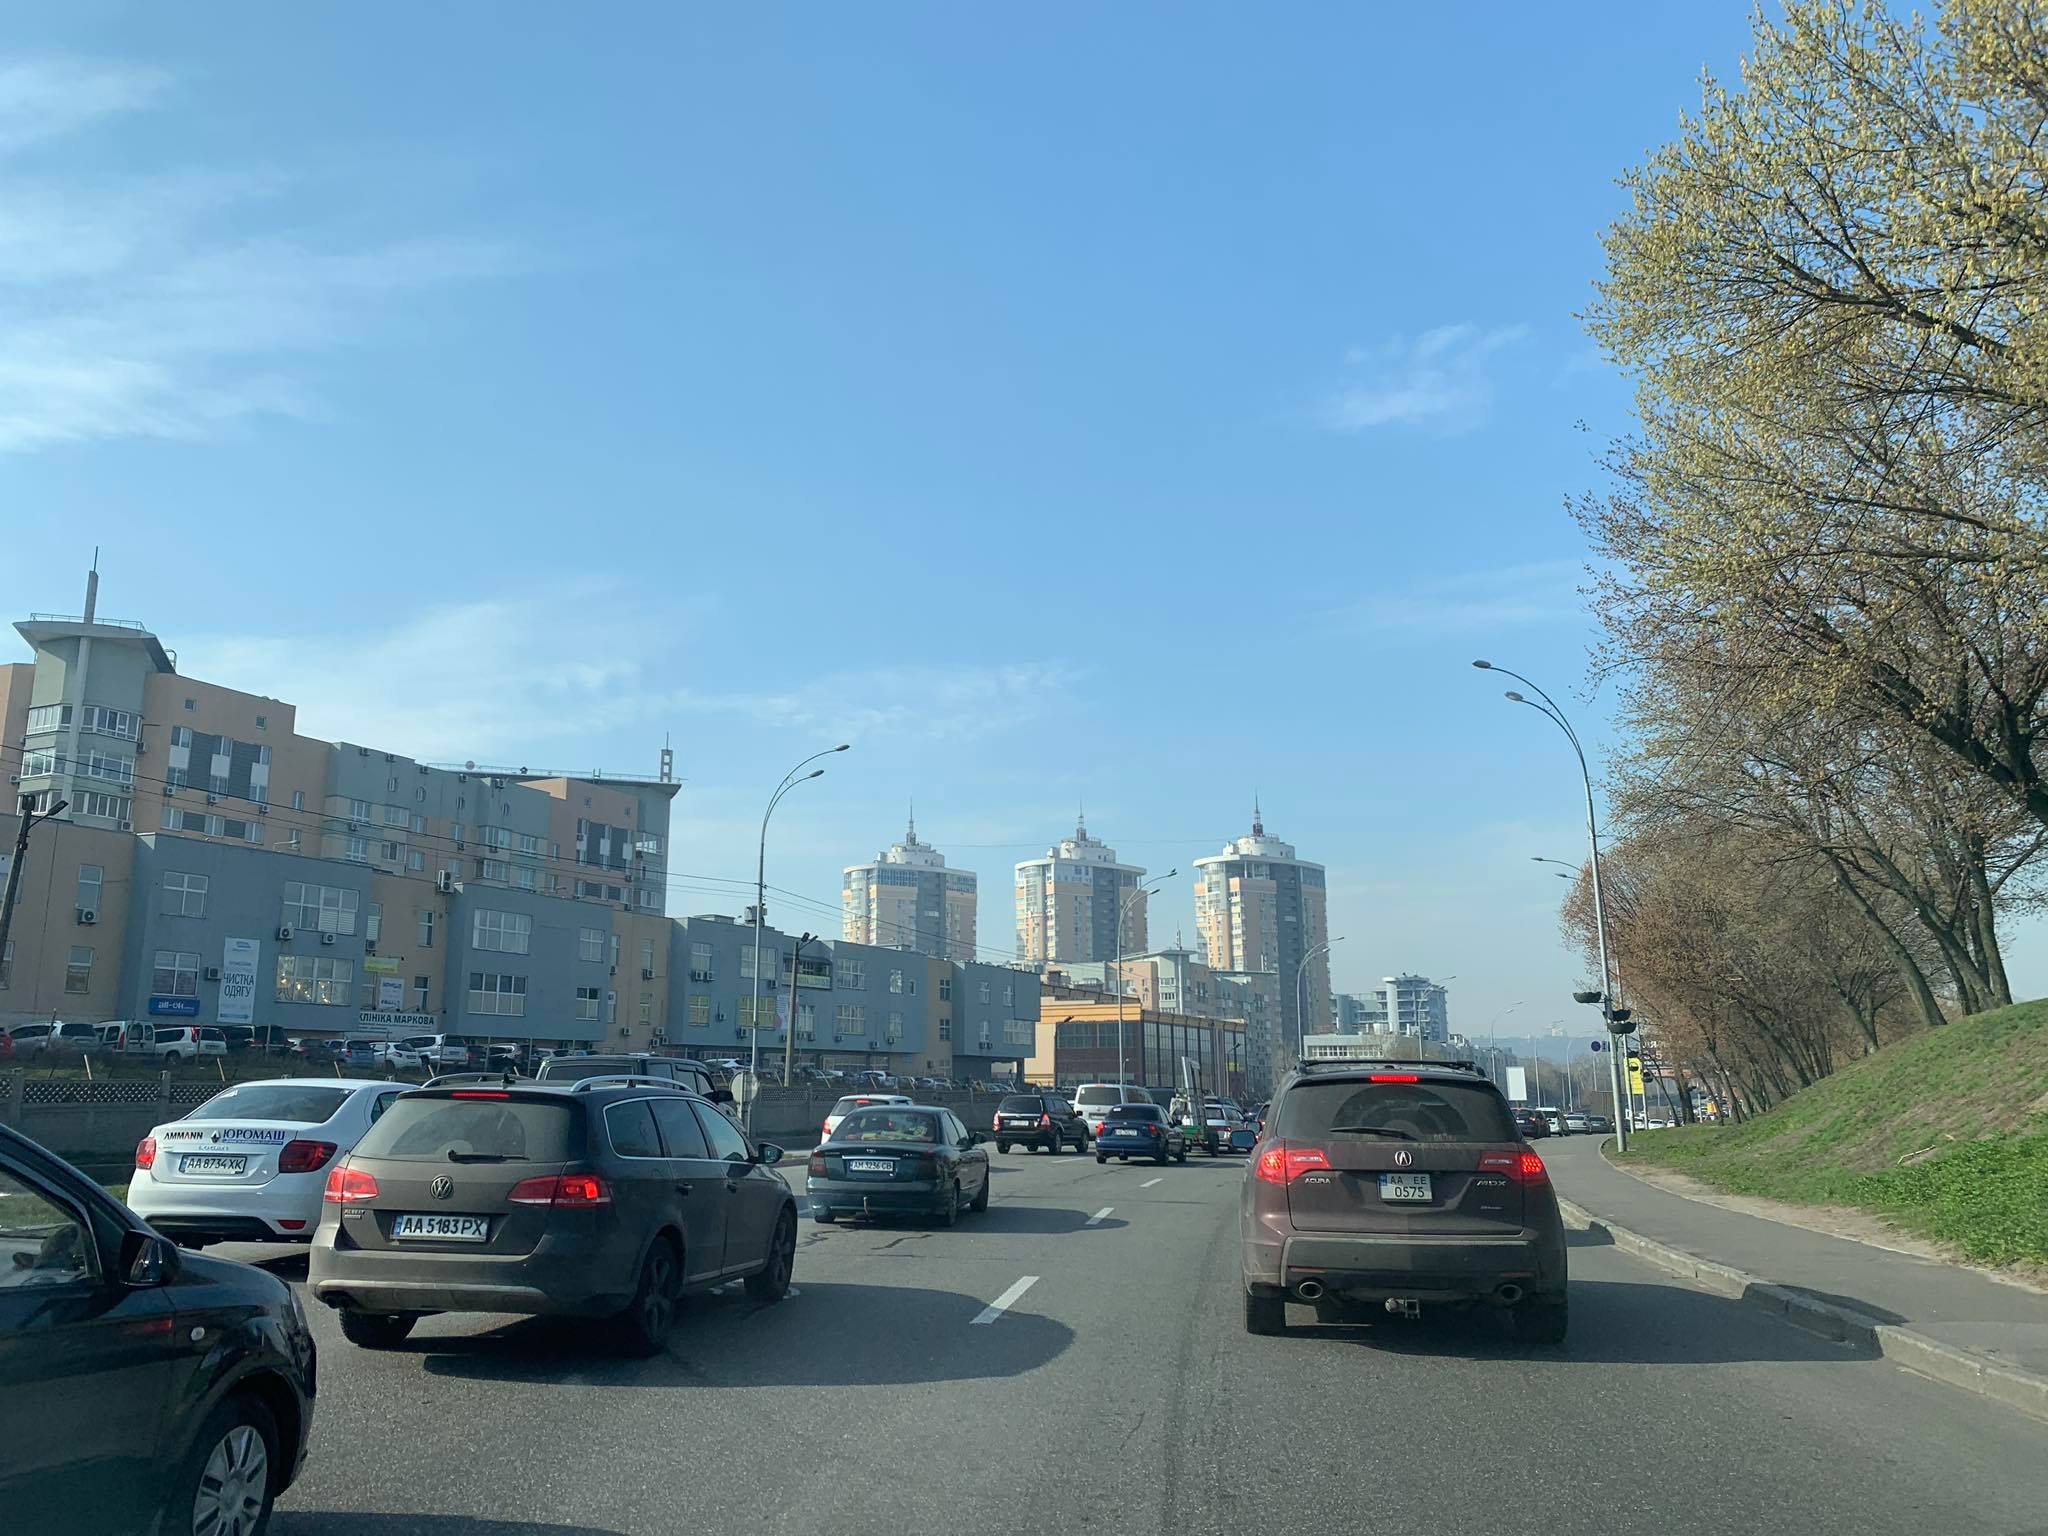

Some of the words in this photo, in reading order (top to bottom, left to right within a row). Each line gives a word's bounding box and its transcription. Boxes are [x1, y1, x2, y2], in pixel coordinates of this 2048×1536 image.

[224, 973, 254, 985] ЧИСТКА
[225, 985, 251, 998] ОДЯГУ
[394, 1015, 434, 1025] МАРКОВА
[164, 1132, 203, 1141] AMMANN
[223, 1129, 285, 1141] ЮРОМАШ
[188, 1159, 201, 1169] AA
[203, 1158, 226, 1170] 8734
[227, 1159, 244, 1170] XK
[1390, 1176, 1404, 1184] AA
[1414, 1177, 1427, 1185] EE
[1395, 1186, 1425, 1198] 0575
[402, 1217, 423, 1233] AA
[426, 1218, 459, 1234] 5183
[461, 1219, 482, 1236] PX
